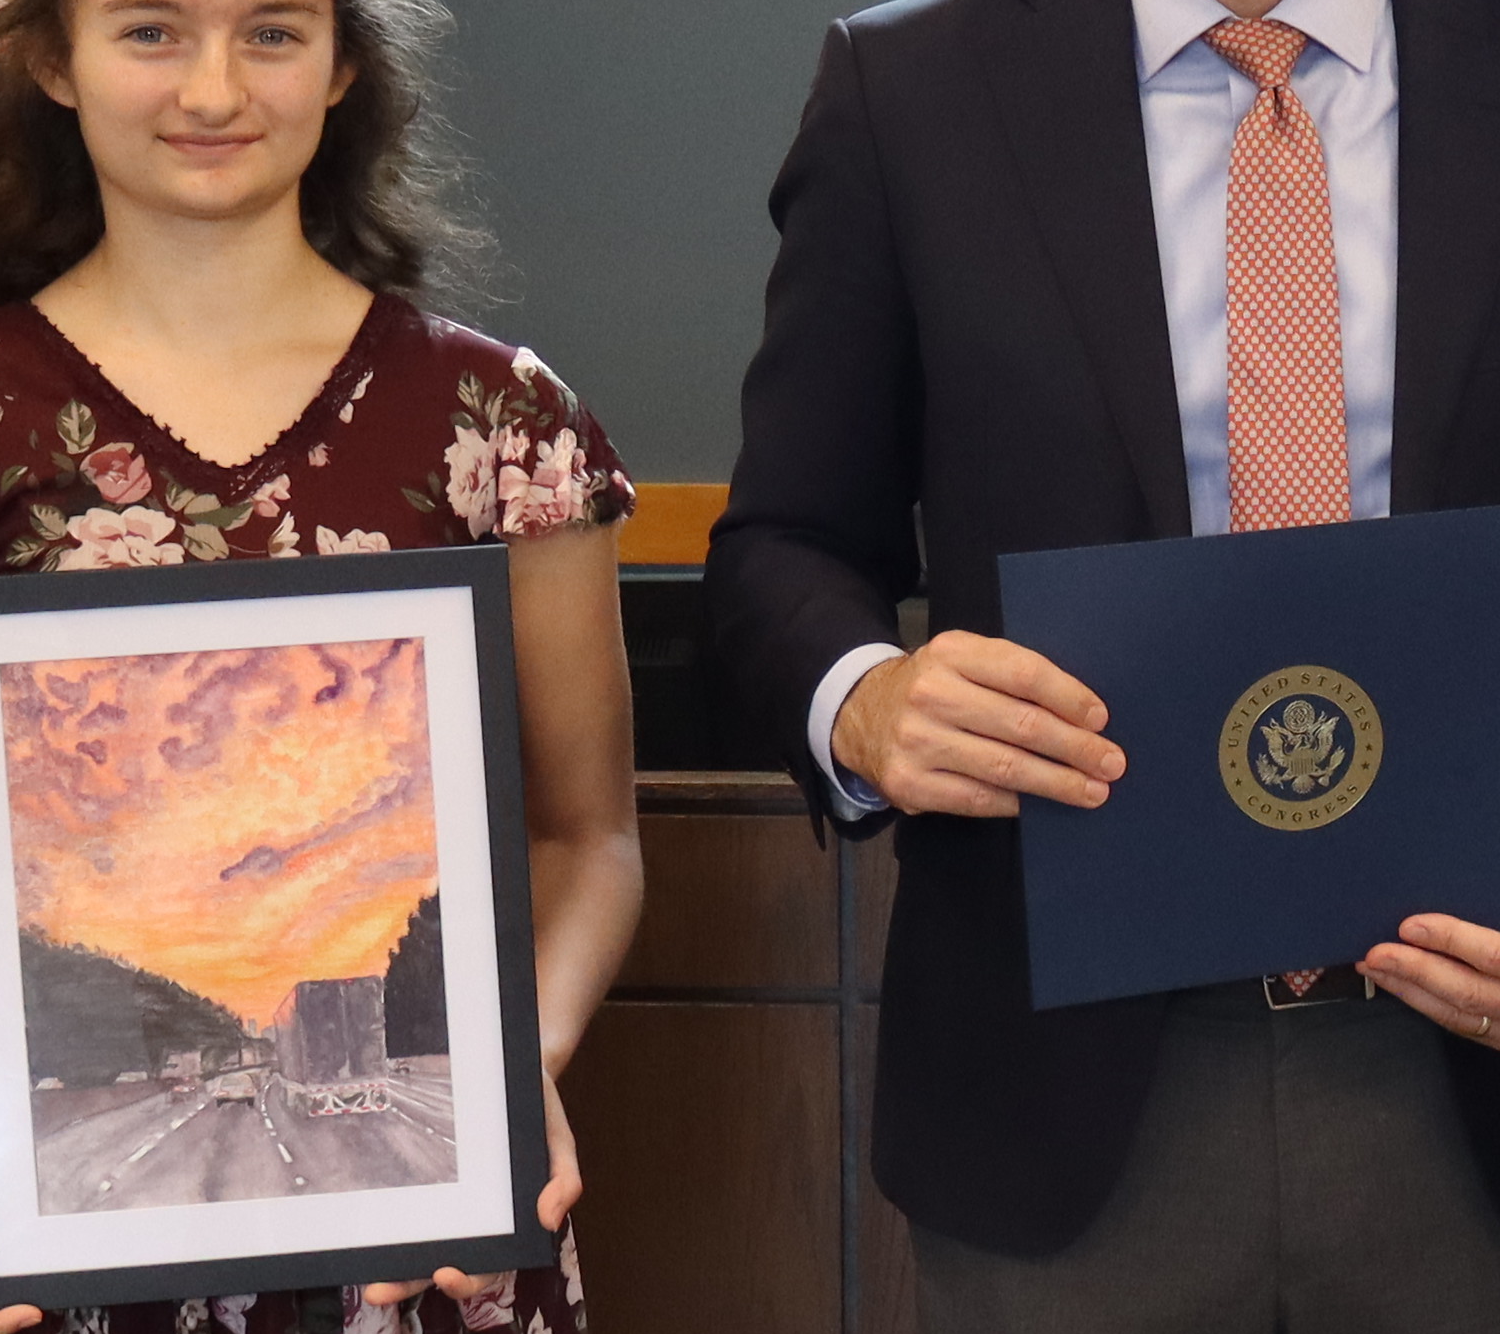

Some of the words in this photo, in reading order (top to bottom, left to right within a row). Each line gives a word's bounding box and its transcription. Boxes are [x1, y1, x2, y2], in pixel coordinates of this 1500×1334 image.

[1228, 676, 1288, 748] UNITED
[1301, 672, 1371, 731] STATES
[1247, 783, 1358, 823] CONGRESS
